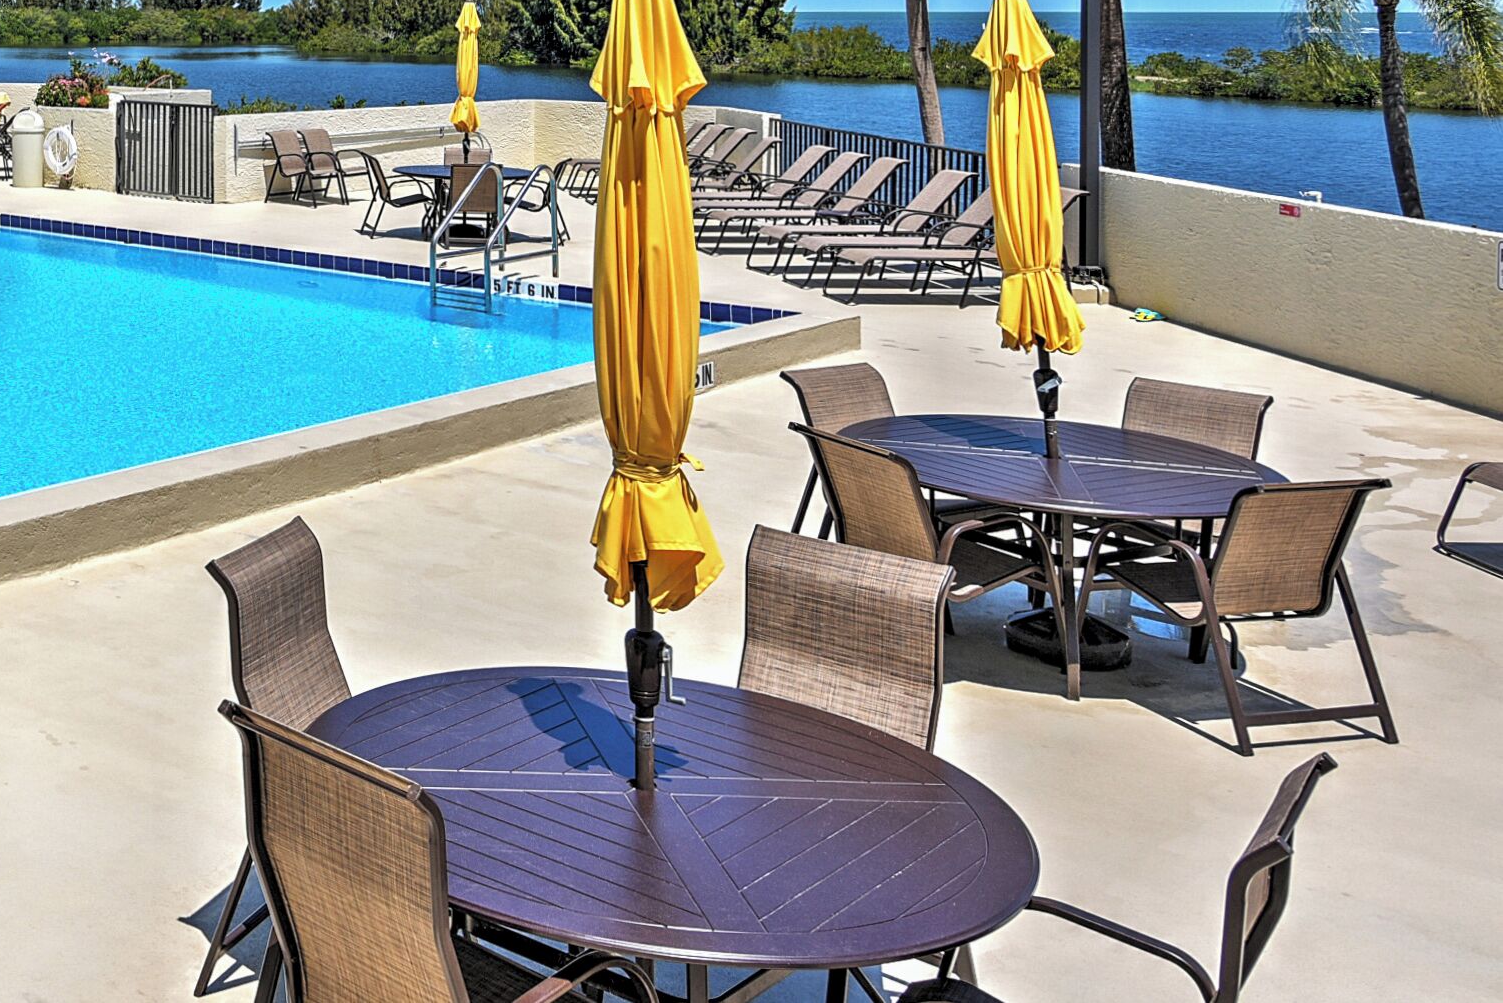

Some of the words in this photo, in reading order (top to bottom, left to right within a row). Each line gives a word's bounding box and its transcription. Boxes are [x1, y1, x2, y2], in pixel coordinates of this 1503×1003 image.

[493, 279, 501, 292] 5
[506, 280, 522, 294] FT
[527, 283, 535, 296] 6
[541, 284, 557, 300] IN.
[702, 363, 713, 387] IN.
